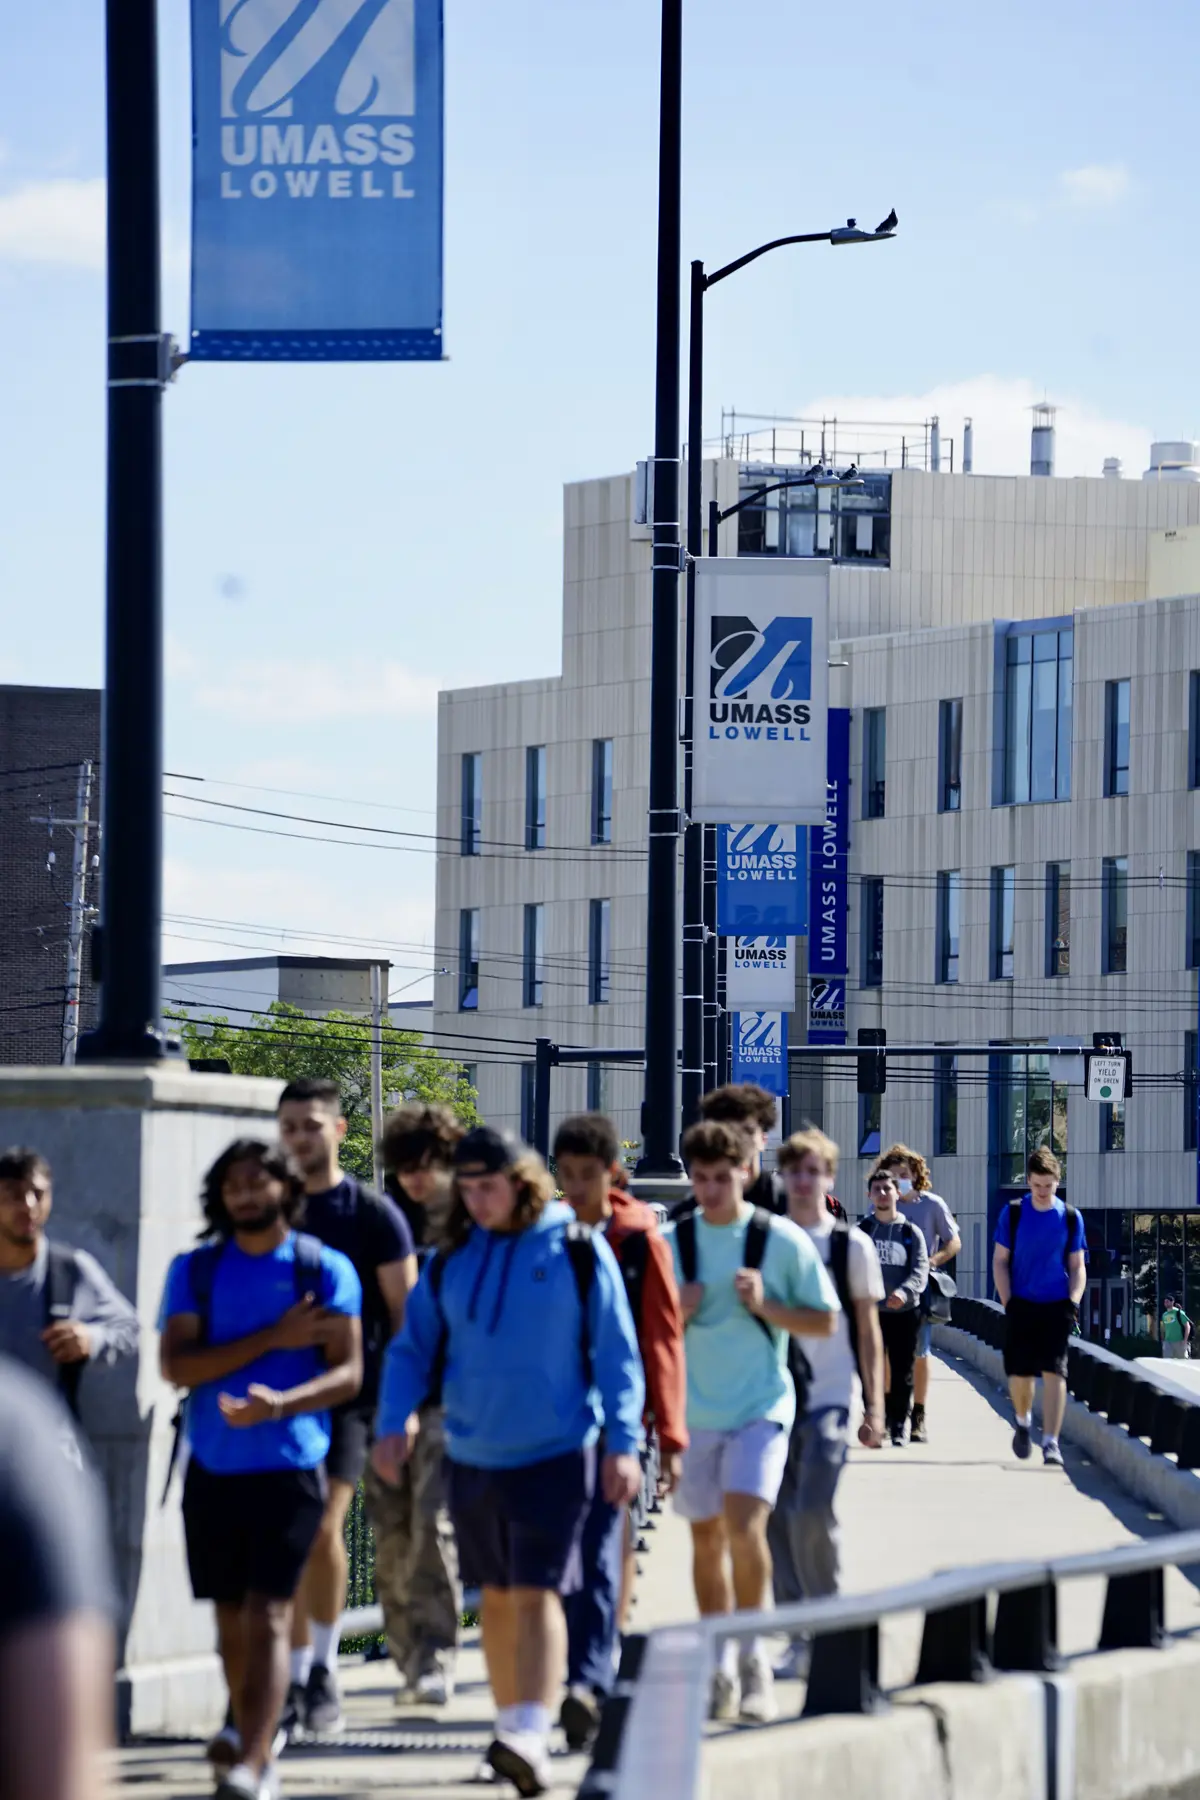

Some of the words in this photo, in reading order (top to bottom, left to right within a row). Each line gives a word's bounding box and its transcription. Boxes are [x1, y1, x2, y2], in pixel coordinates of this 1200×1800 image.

[221, 123, 415, 165] UMASS
[221, 170, 415, 199] LOWELL
[709, 703, 811, 725] UMASS
[709, 726, 811, 741] LOWELL
[823, 780, 838, 869] LOWELL
[727, 854, 797, 869] UMASS
[727, 870, 797, 881] LOWELL
[821, 881, 836, 961] UMASS
[735, 949, 786, 960] UMASS
[735, 961, 787, 969] LOWELL
[811, 1011, 845, 1019] UMASS
[739, 1046, 782, 1056] UMASS
